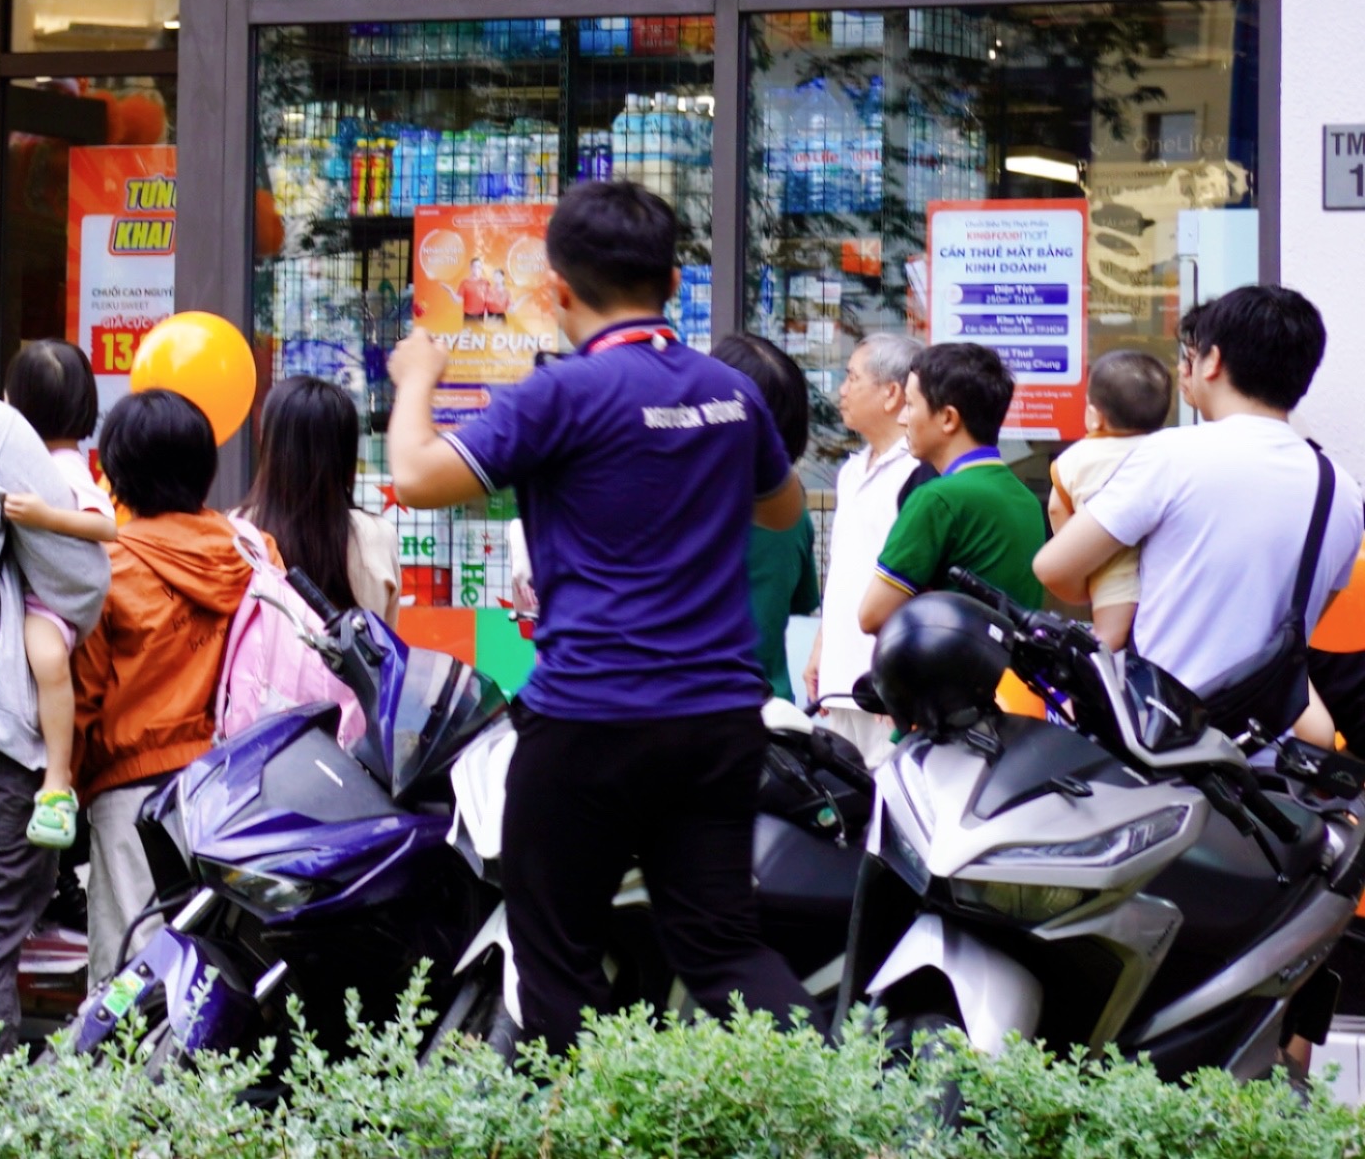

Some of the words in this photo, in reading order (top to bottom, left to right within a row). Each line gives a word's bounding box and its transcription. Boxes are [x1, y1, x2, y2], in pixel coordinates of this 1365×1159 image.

[115, 221, 174, 251] KHAI
[965, 262, 996, 274] KINH
[101, 333, 135, 371] 13
[491, 332, 554, 355] DỤNG
